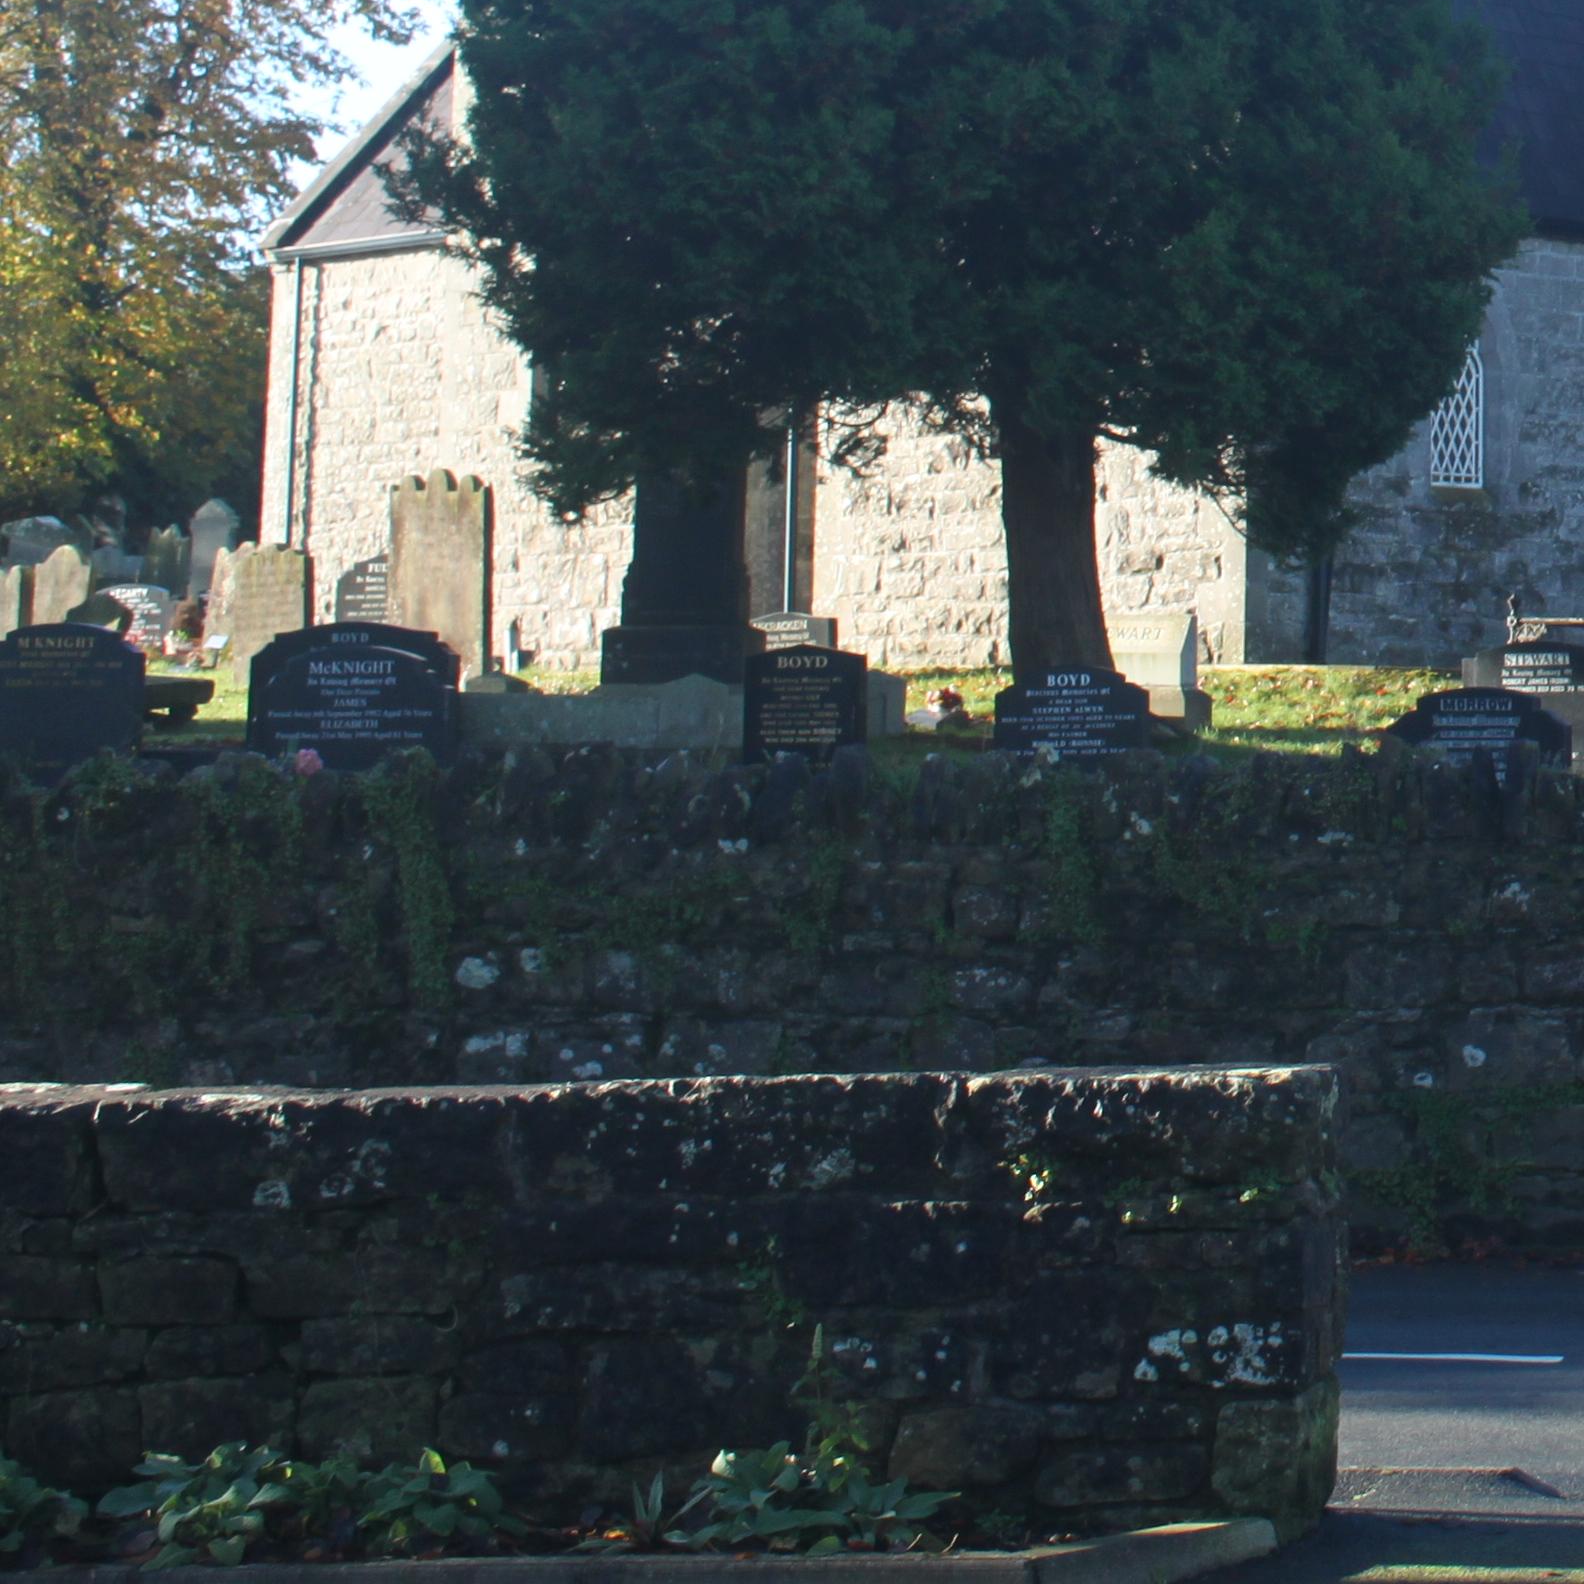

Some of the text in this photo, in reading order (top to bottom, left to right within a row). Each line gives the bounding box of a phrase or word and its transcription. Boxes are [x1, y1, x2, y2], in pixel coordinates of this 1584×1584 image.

[17, 637, 96, 648] MKNIGHT
[331, 632, 369, 643] BOYD
[777, 656, 828, 669] BOYD
[1504, 653, 1570, 667] STEWART
[309, 661, 395, 674] McKNIGHT
[1047, 674, 1090, 687] BOYD
[334, 698, 367, 707] JAMES
[1440, 698, 1512, 711] MORROW
[320, 720, 379, 729] ELIZABETH
